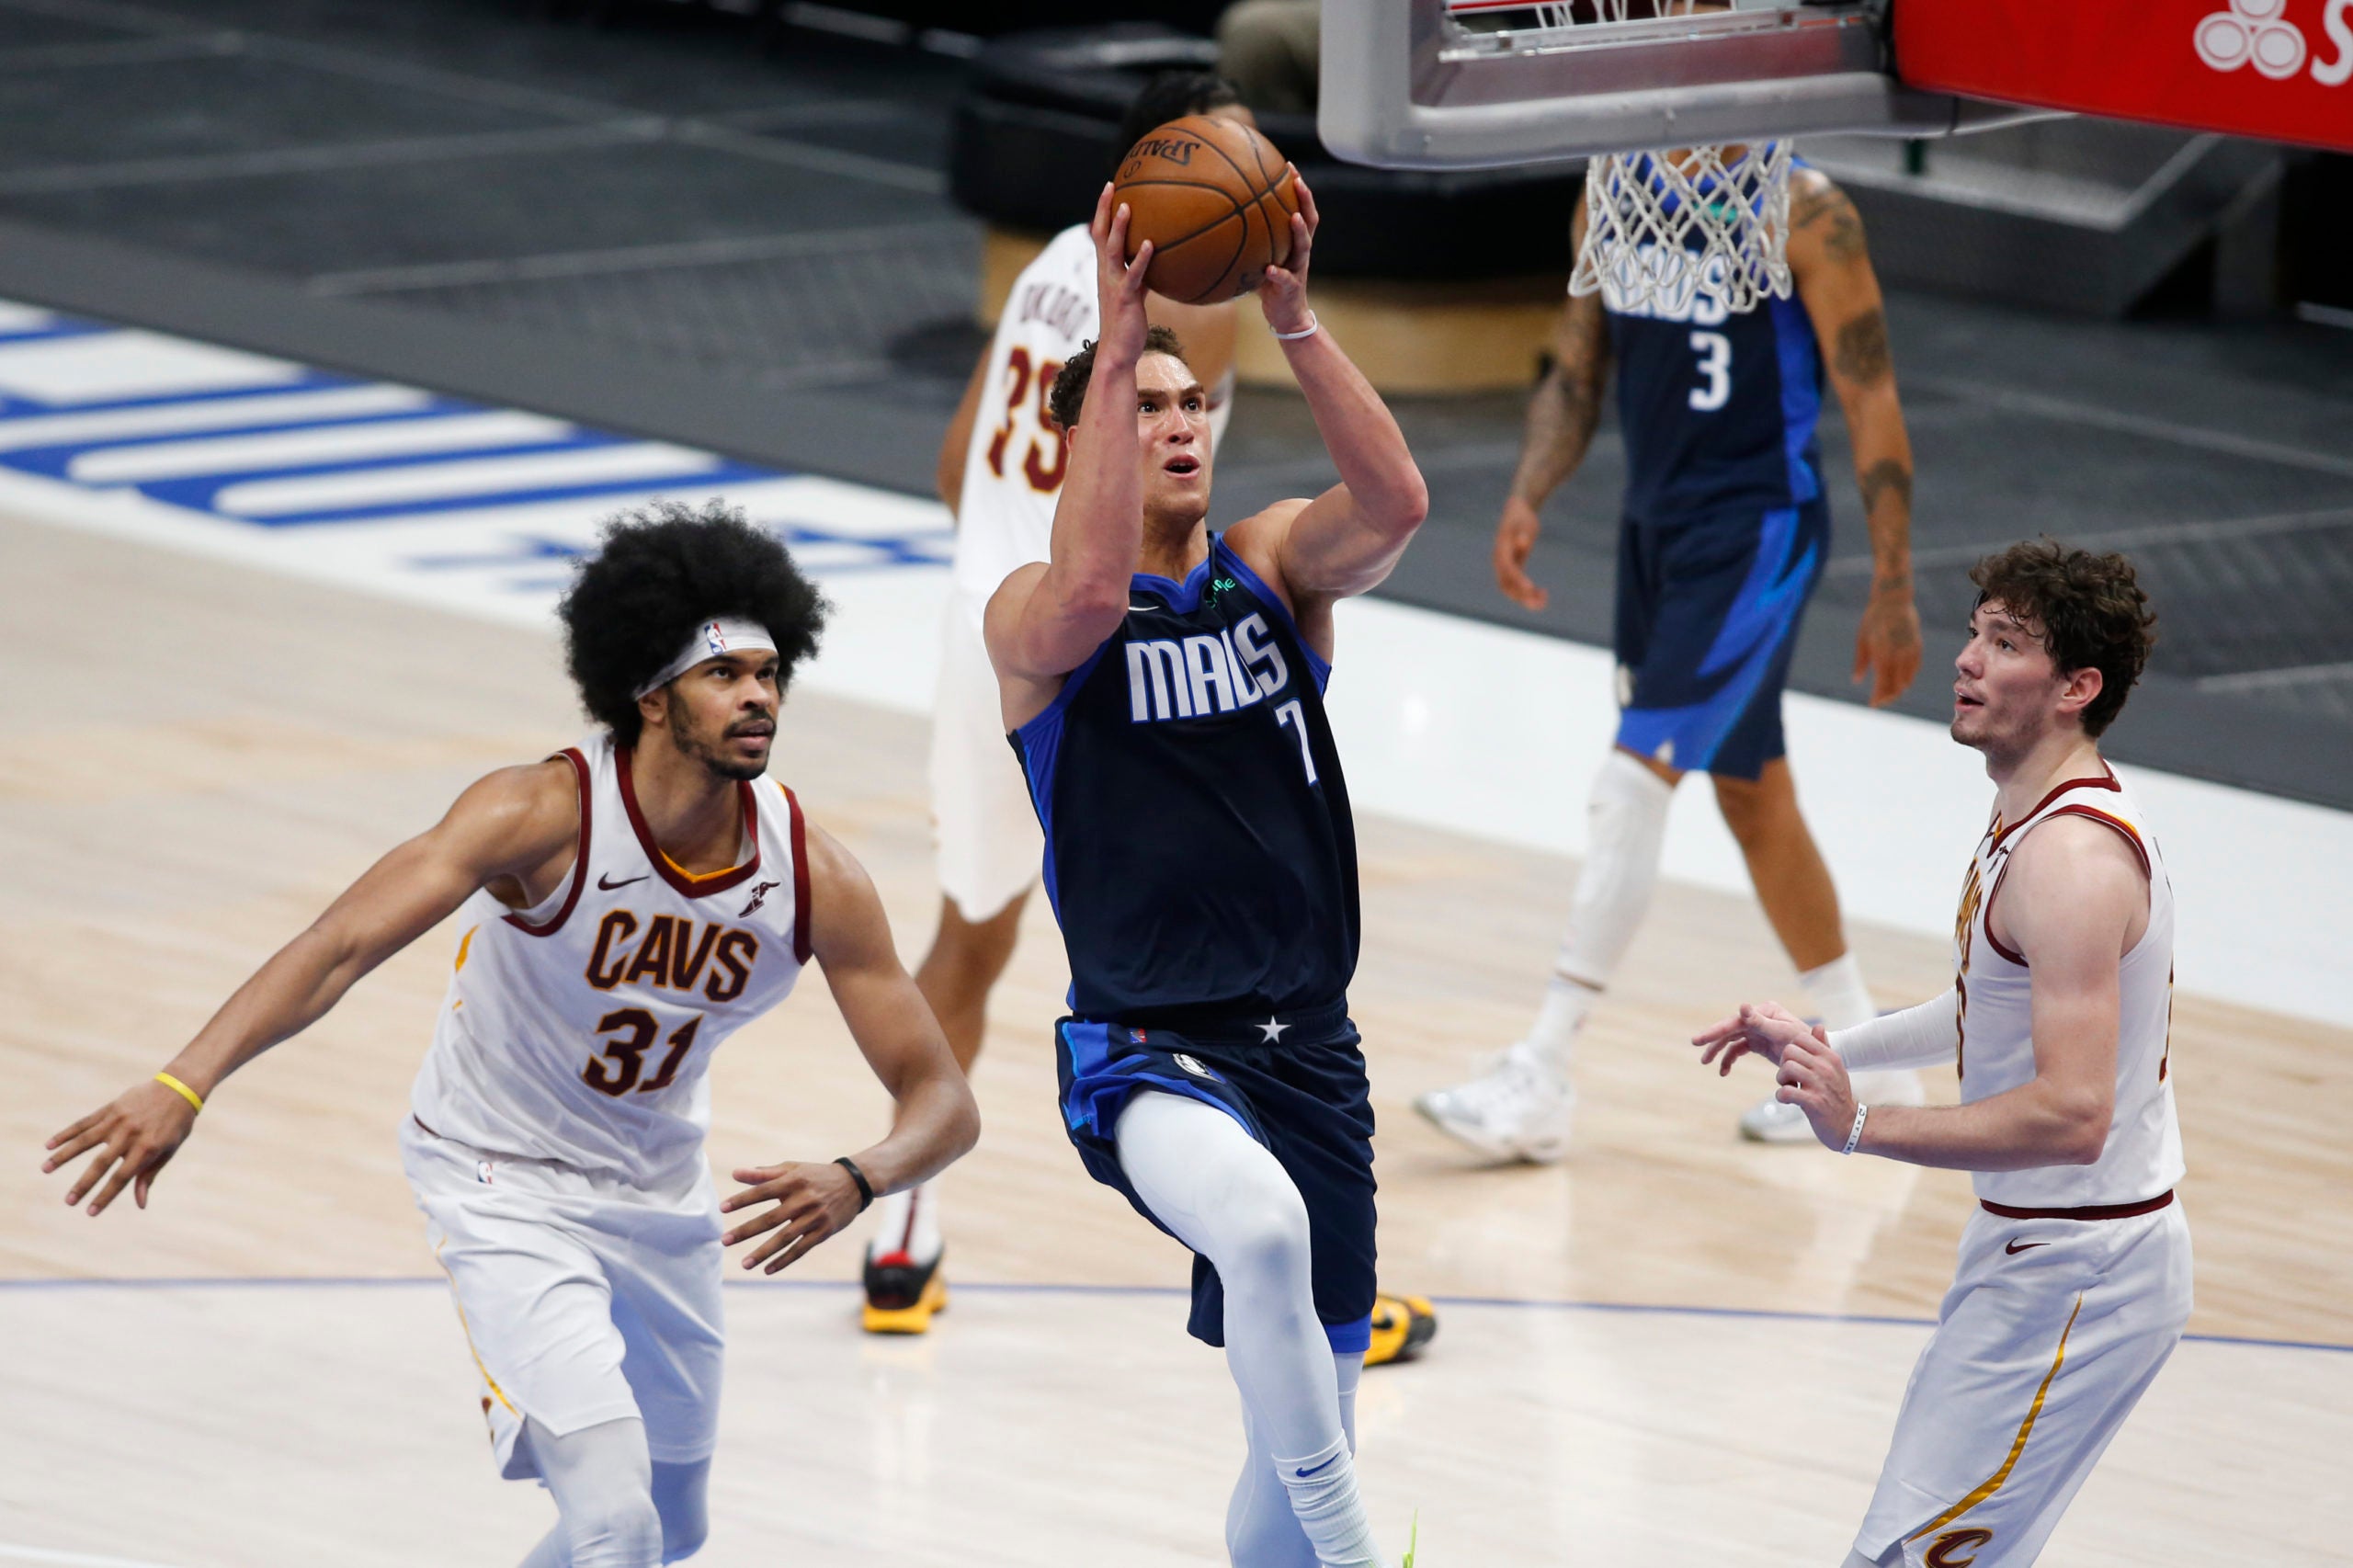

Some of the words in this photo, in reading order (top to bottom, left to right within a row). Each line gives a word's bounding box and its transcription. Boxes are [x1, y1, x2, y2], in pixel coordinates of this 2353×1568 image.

[1688, 332, 1732, 412] 3
[1275, 697, 1319, 787] 7
[585, 908, 759, 1003] CAVS
[583, 1007, 705, 1097] 31
